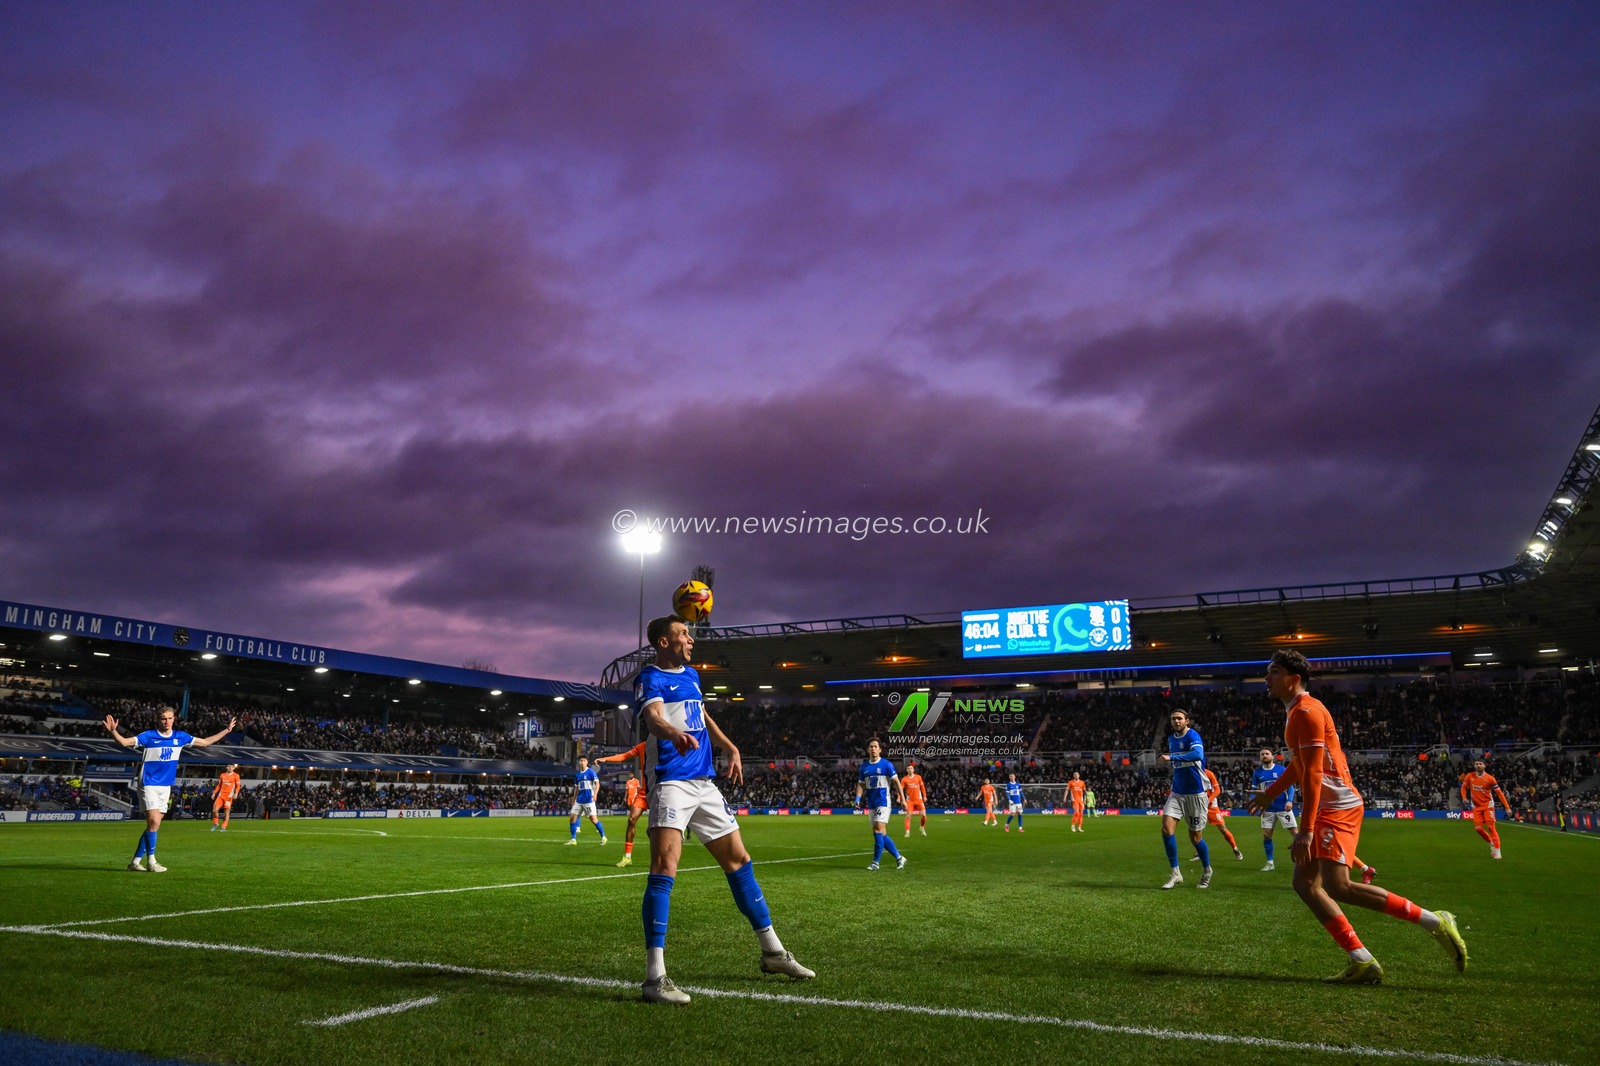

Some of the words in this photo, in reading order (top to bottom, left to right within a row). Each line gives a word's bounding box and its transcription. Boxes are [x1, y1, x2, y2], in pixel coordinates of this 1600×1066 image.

[1028, 609, 1050, 624] THE
[1111, 607, 1121, 624] 0
[5, 606, 102, 633] MINGHAM
[114, 621, 157, 641] CITY
[964, 622, 1000, 639] 46:04
[1112, 626, 1122, 644] 0
[206, 634, 282, 658] FOOTBALL
[292, 647, 325, 664] CLUB
[1100, 669, 1138, 679] TILTON
[406, 810, 431, 818] DELTA
[1189, 815, 1200, 826] 18
[1285, 814, 1291, 823] 9
[1381, 811, 1395, 819] sky
[1397, 810, 1413, 819] bet
[1446, 811, 1461, 819] sky
[1463, 811, 1474, 819] be
